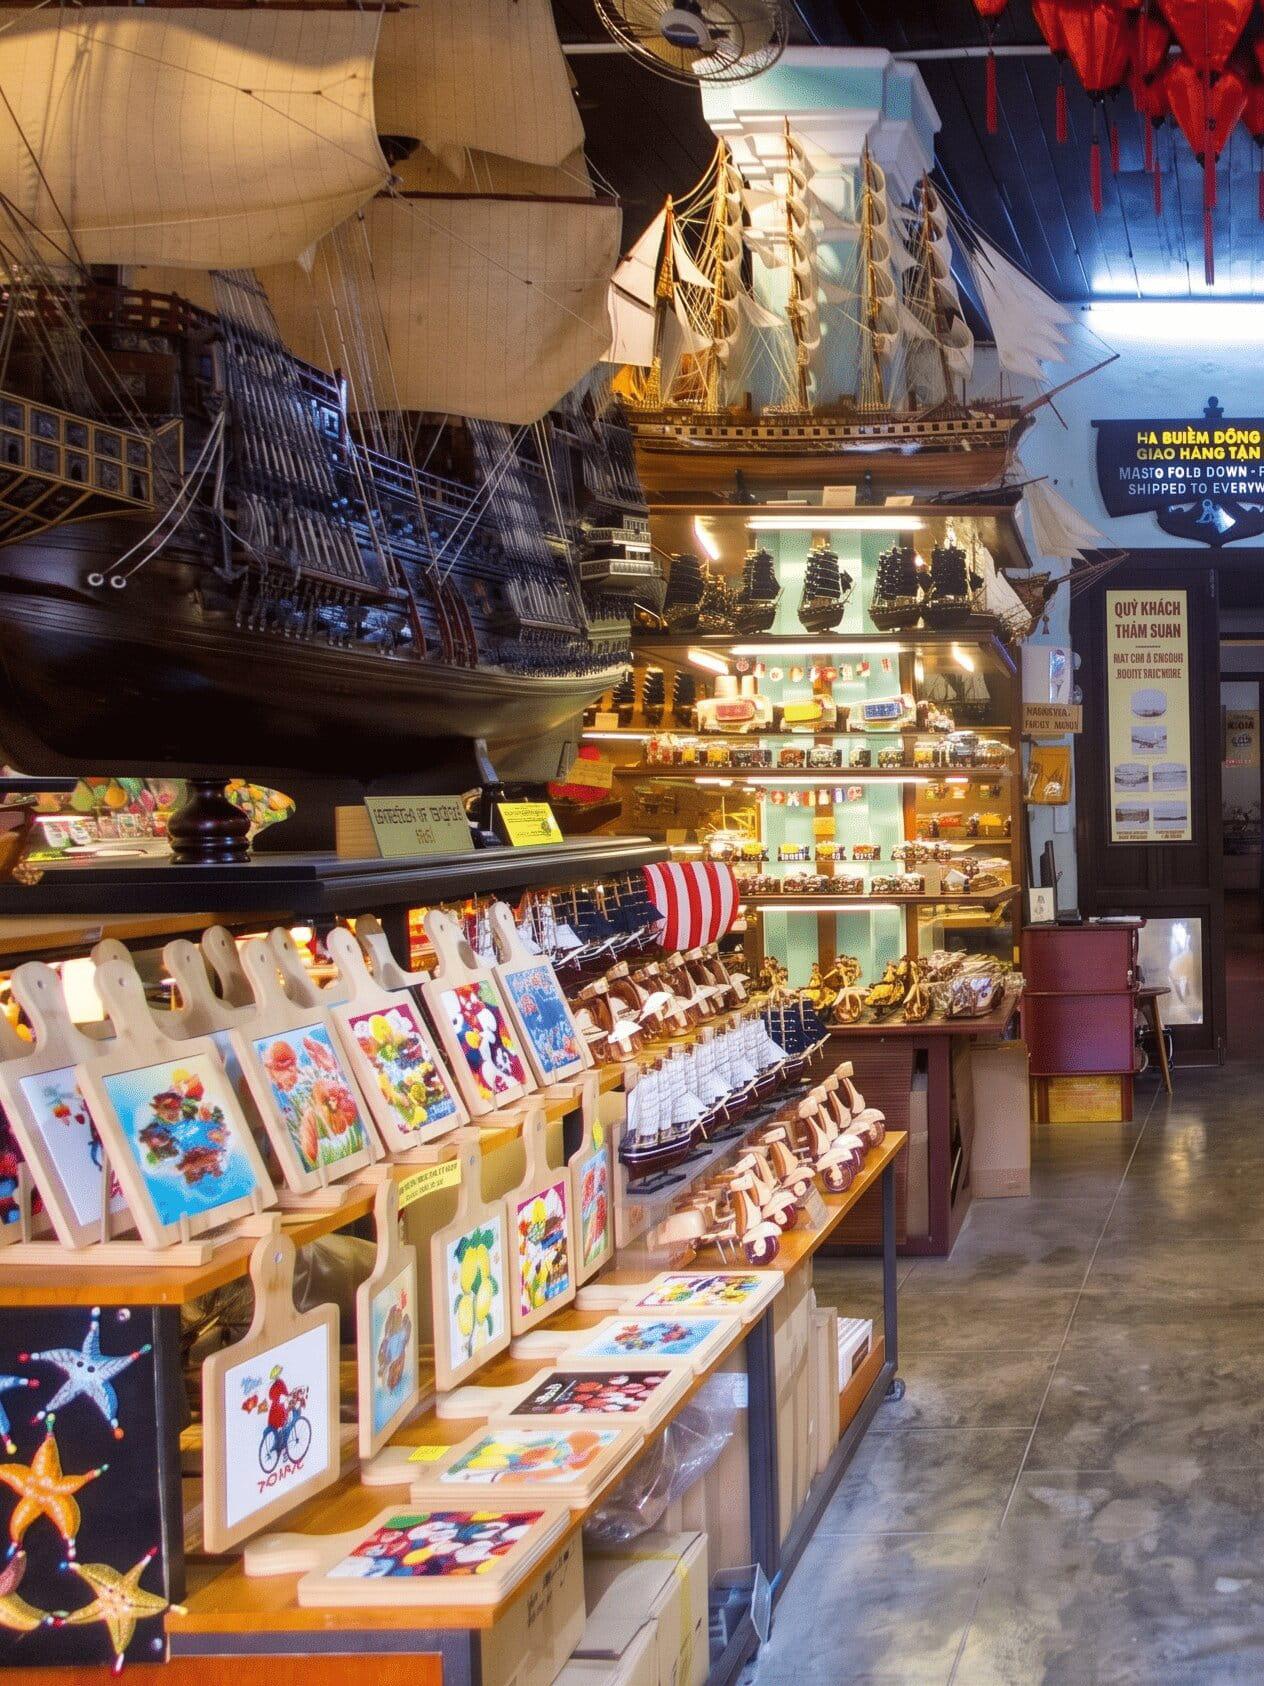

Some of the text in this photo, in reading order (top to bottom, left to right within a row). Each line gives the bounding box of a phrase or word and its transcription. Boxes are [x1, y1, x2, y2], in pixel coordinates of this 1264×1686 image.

[1137, 448, 1175, 460] GIAO
[1206, 465, 1247, 478] DOWN
[1128, 482, 1187, 495] SHIPPED
[1191, 482, 1208, 495] TO
